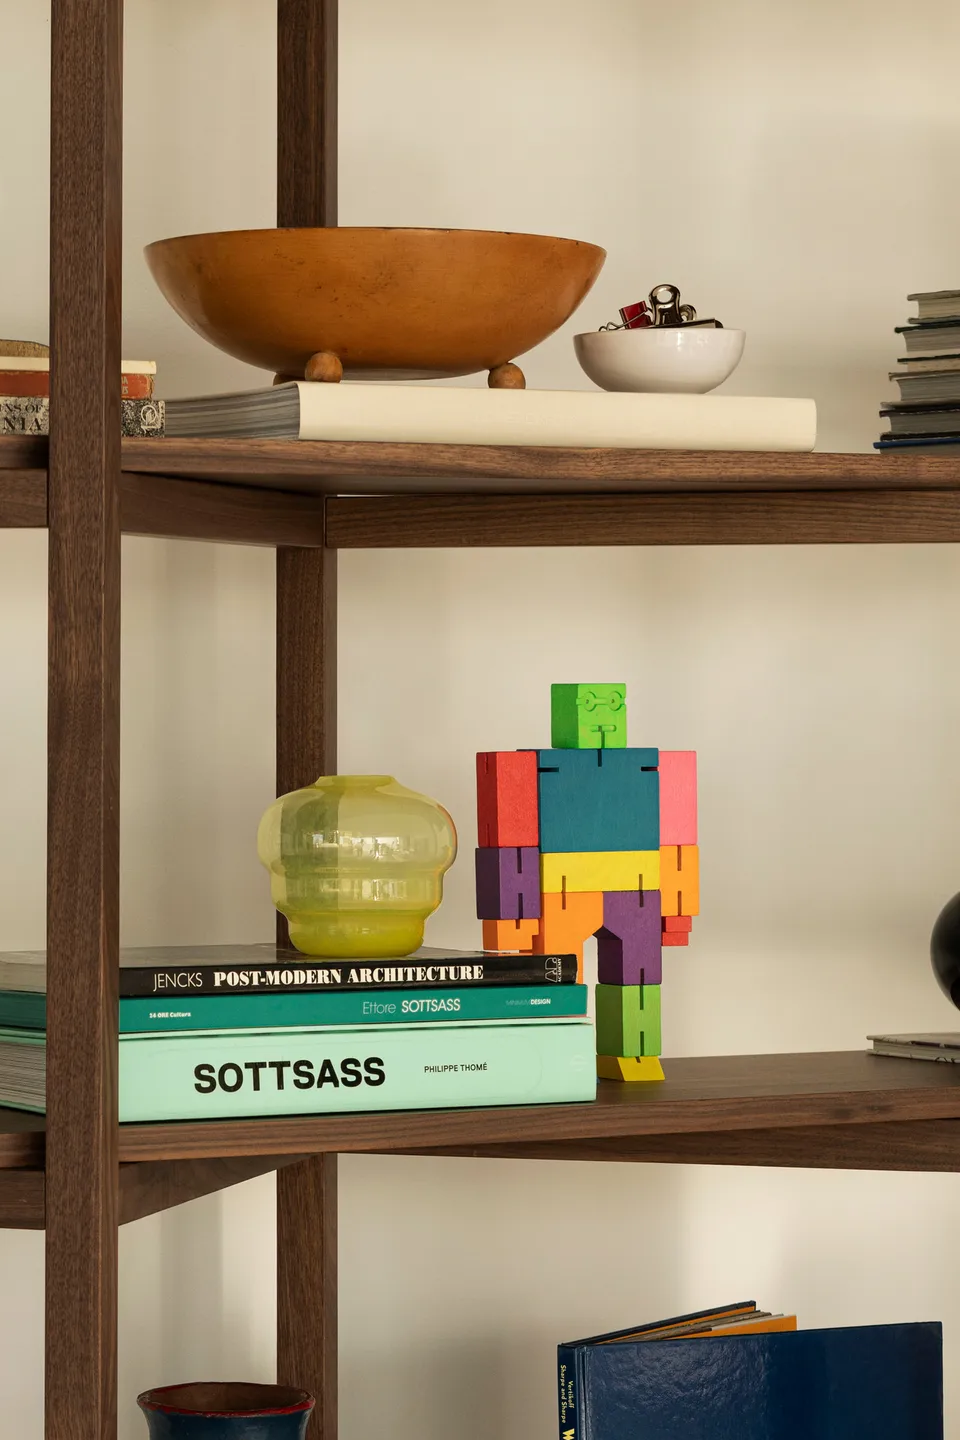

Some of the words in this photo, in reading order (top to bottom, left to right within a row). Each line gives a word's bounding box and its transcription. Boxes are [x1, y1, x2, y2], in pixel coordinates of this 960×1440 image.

[25, 404, 43, 414] OF
[153, 972, 203, 992] JENCKS
[214, 969, 342, 987] POST-MODERN
[347, 965, 484, 984] ARCHITECTURE
[363, 1001, 397, 1014] Ettore
[401, 998, 461, 1014] SOTTSASS
[193, 1056, 386, 1094] SOTTSASS
[424, 1064, 459, 1073] PHILIPPE
[461, 1062, 488, 1072] THOMÉ
